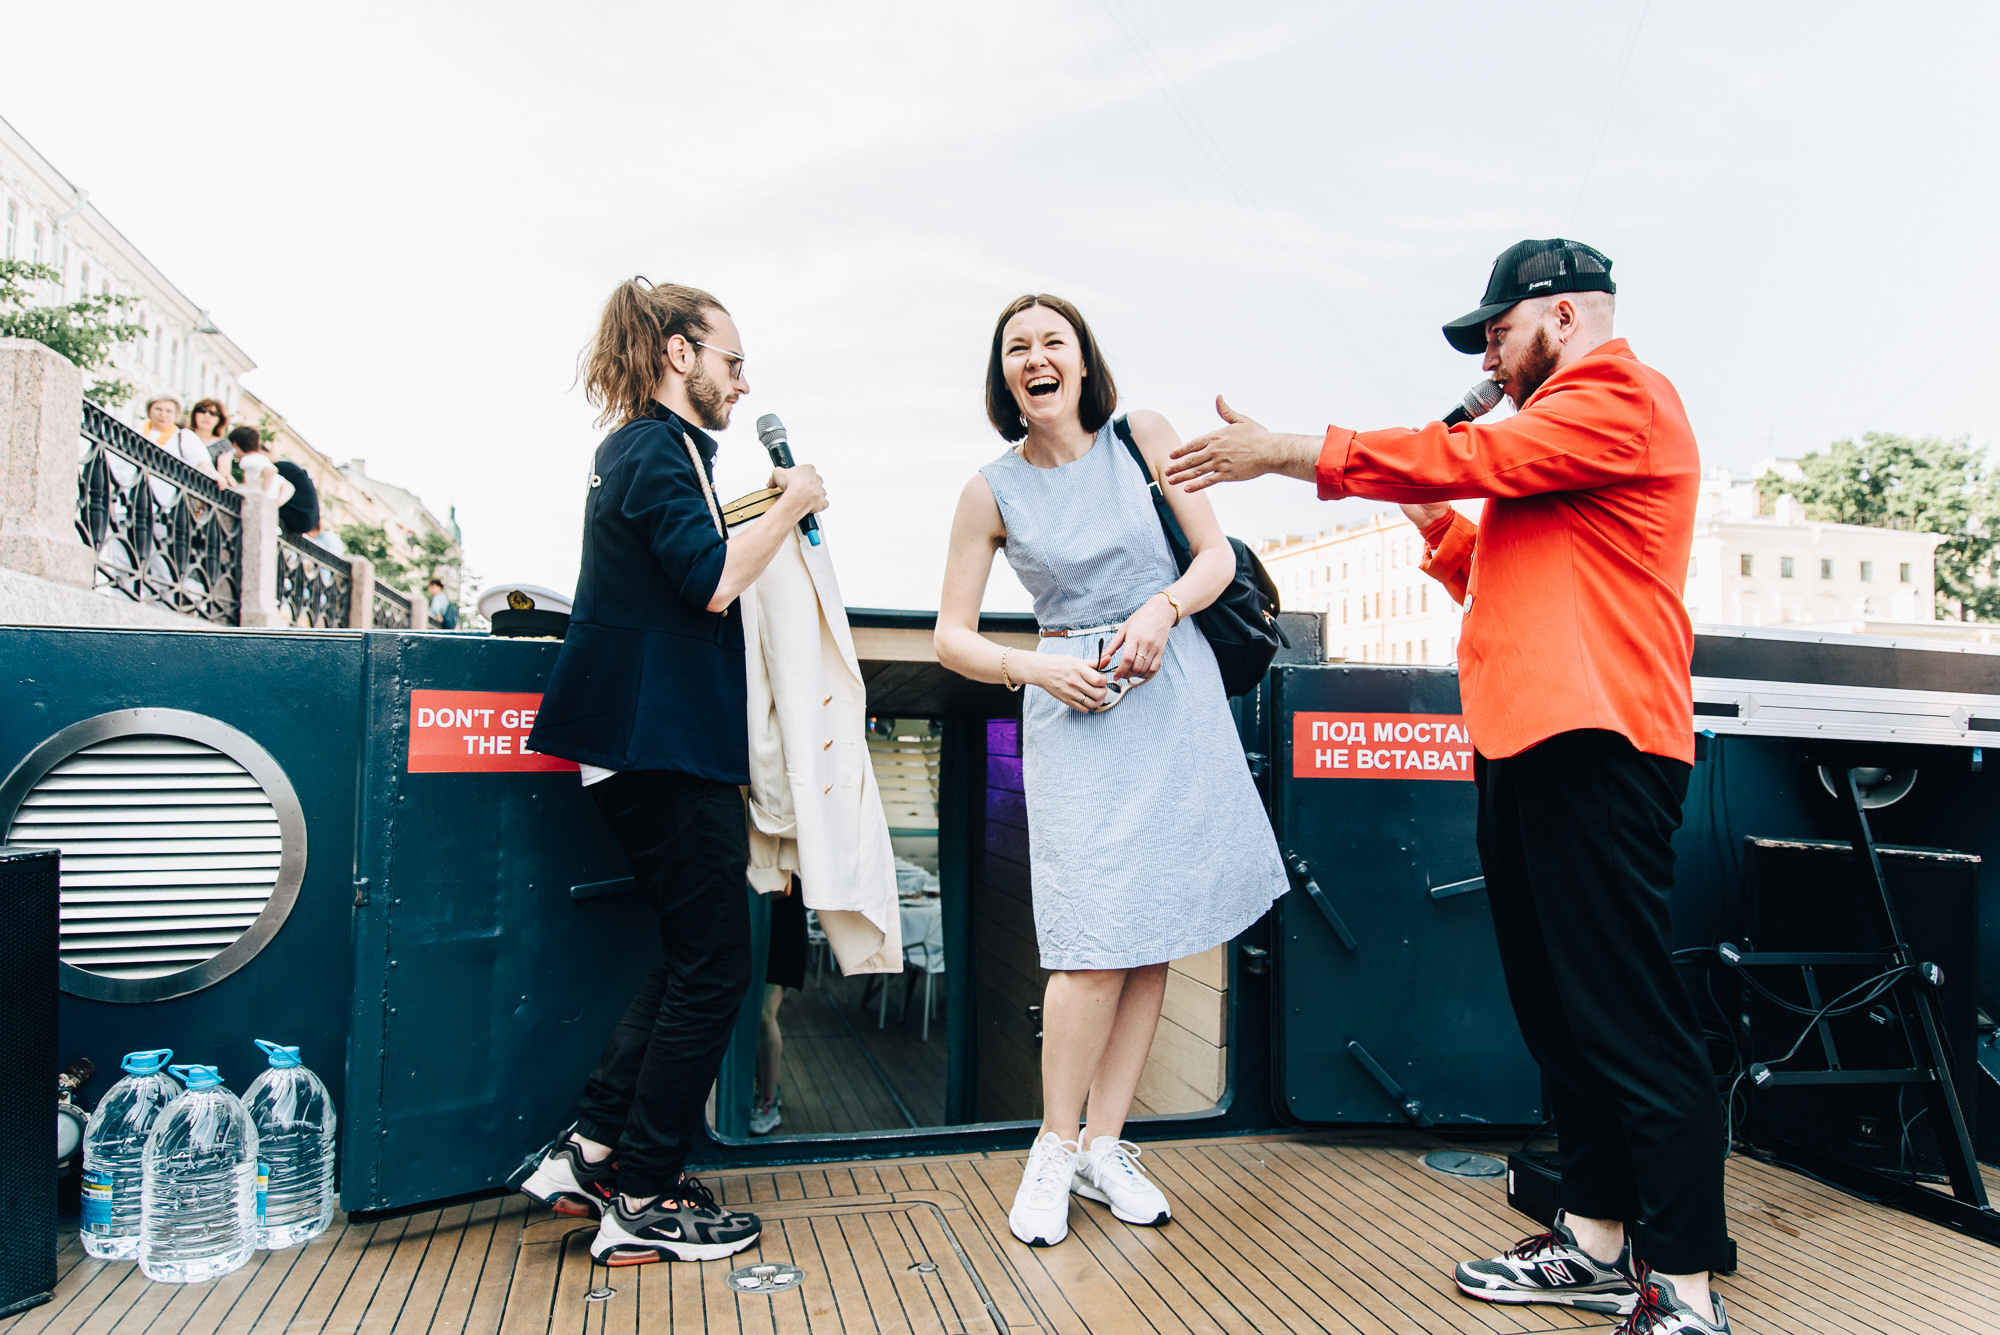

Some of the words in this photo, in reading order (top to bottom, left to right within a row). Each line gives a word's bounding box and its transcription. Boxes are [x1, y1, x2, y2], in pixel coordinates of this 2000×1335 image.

[417, 707, 495, 728] DON'T
[500, 709, 539, 729] GE
[462, 735, 512, 755] THE
[1312, 721, 1366, 746] ПОД
[1315, 748, 1349, 769] НЕ
[1357, 749, 1472, 771] ВСТАВАТ
[1538, 1260, 1576, 1286] N
